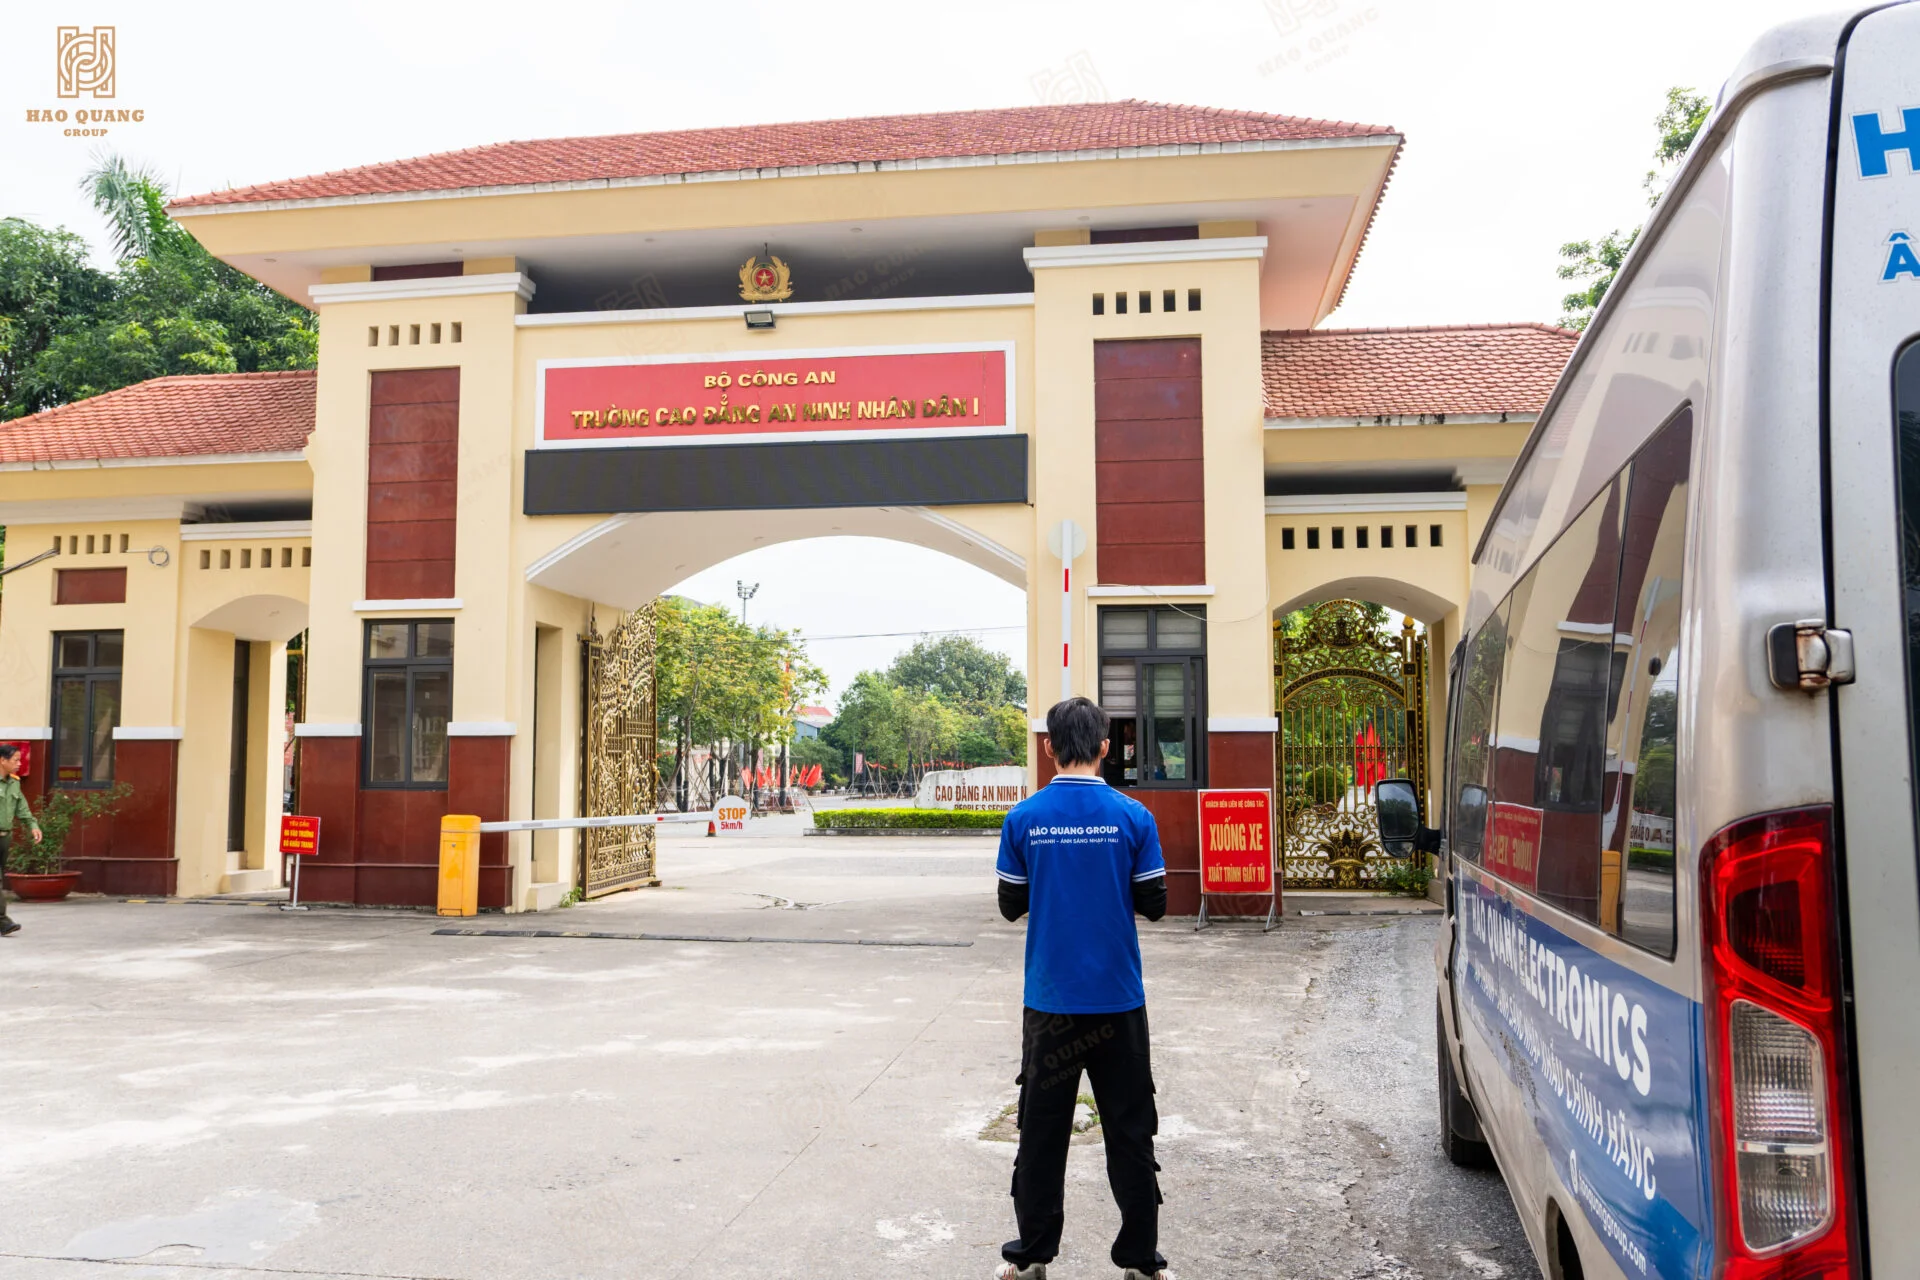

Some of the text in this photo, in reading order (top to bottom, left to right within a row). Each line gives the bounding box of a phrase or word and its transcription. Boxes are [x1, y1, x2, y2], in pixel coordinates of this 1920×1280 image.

[704, 370, 836, 391] BỘ CÔNG AN
[571, 394, 979, 428] TRƯỜNG CAO ĐẲNG AN NINH NHÂN DÂN I
[935, 785, 953, 802] CAO
[956, 778, 980, 802] ĐẲNG
[982, 786, 994, 802] AN
[996, 786, 1018, 802] NINH
[719, 808, 746, 820] STOP
[721, 821, 742, 830] 5km/h
[1030, 826, 1118, 836] HÀO QUANG GROUP
[1209, 816, 1264, 851] XUỐNG XE
[1208, 862, 1265, 882] XUẤT TRÌNH GIẤY TỜ
[1517, 928, 1651, 1097] ELECTRONICS
[1540, 1036, 1564, 1098] KHẨU
[1564, 1071, 1604, 1146] CHÍNH
